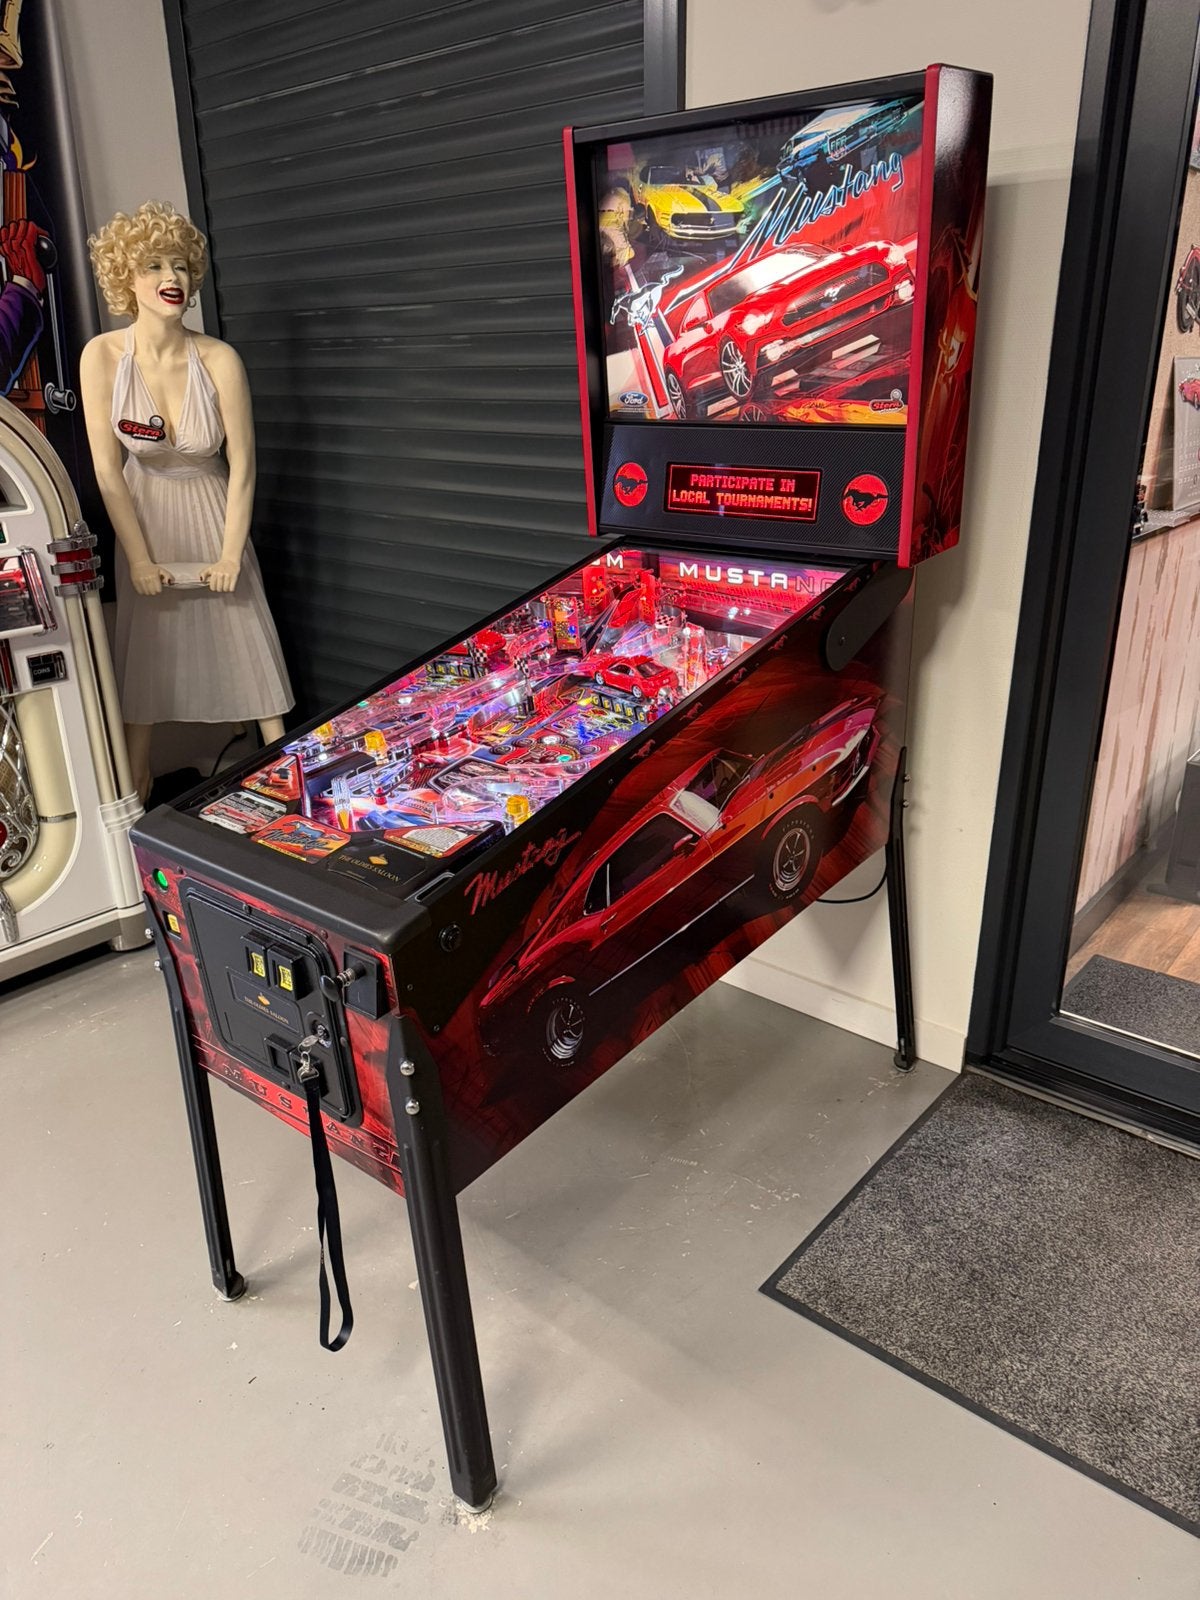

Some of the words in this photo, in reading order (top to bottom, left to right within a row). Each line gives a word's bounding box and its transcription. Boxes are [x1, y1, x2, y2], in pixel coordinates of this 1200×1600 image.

[740, 152, 904, 262] Mustang
[624, 392, 645, 405] Ford
[122, 422, 161, 437] Stern
[690, 473, 776, 491] PARTICIPATE
[780, 478, 796, 493] IN
[672, 489, 711, 505] LOCAL
[716, 492, 813, 512] TOURNAMENTS!
[33, 666, 51, 677] COINS
[221, 1062, 392, 1163] MUSANG
